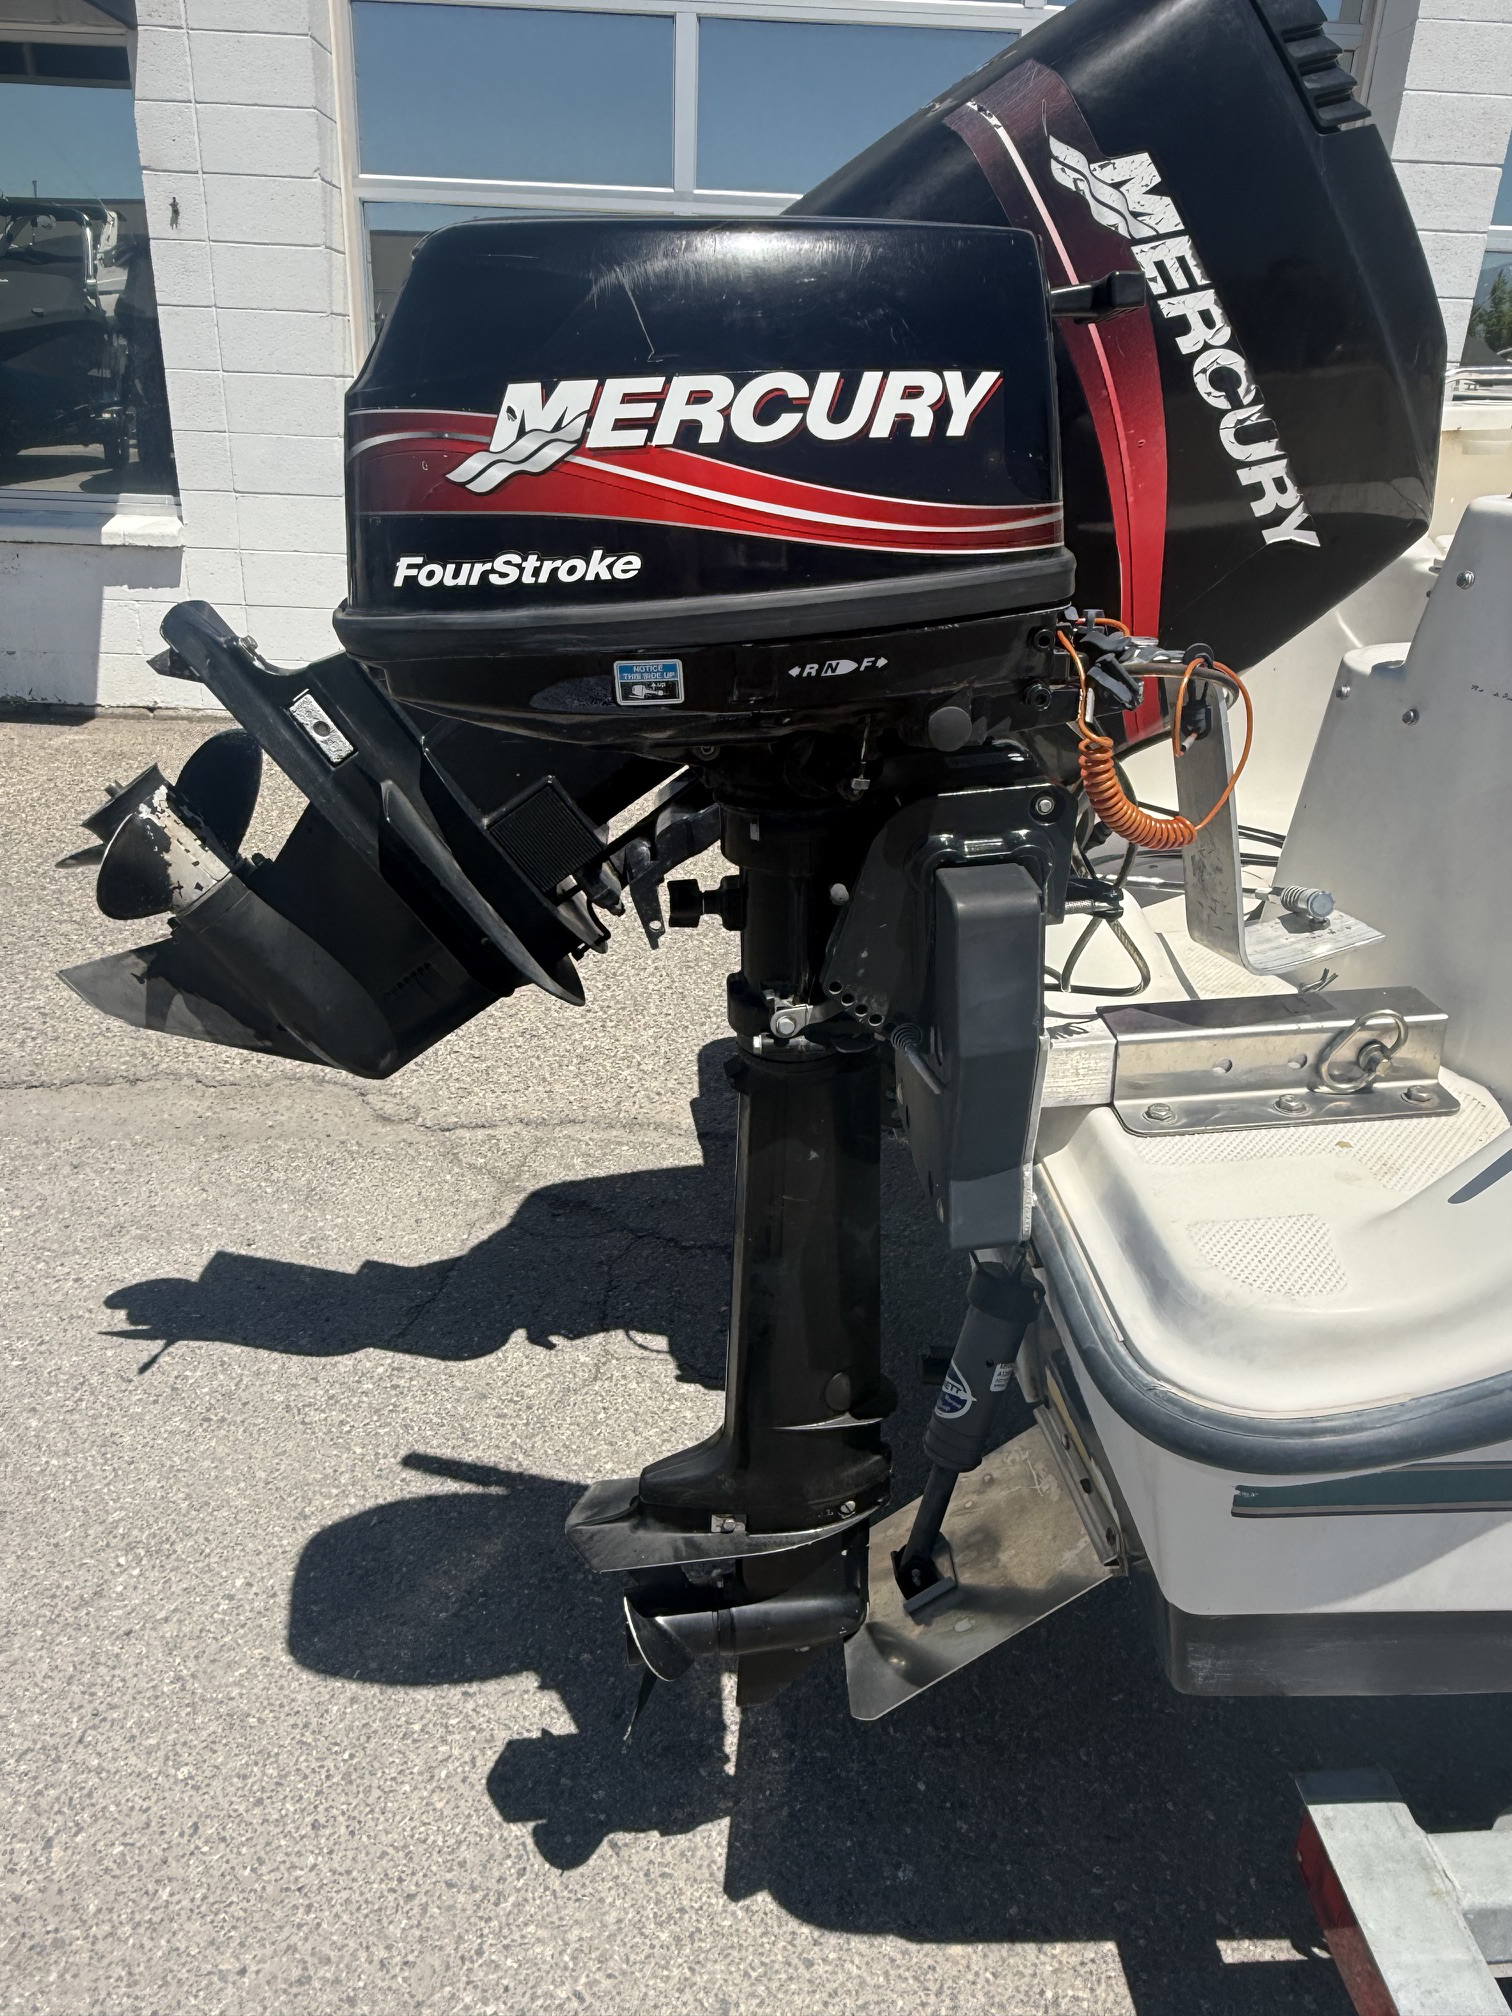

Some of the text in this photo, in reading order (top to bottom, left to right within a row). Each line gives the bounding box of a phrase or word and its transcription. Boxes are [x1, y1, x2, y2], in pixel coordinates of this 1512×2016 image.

[1089, 151, 1321, 548] MERCURY
[489, 371, 1003, 452] MERCURY
[393, 549, 642, 587] FourStroke
[633, 665, 664, 673] NOTICE
[663, 671, 675, 679] UP
[802, 657, 876, 678] R N F
